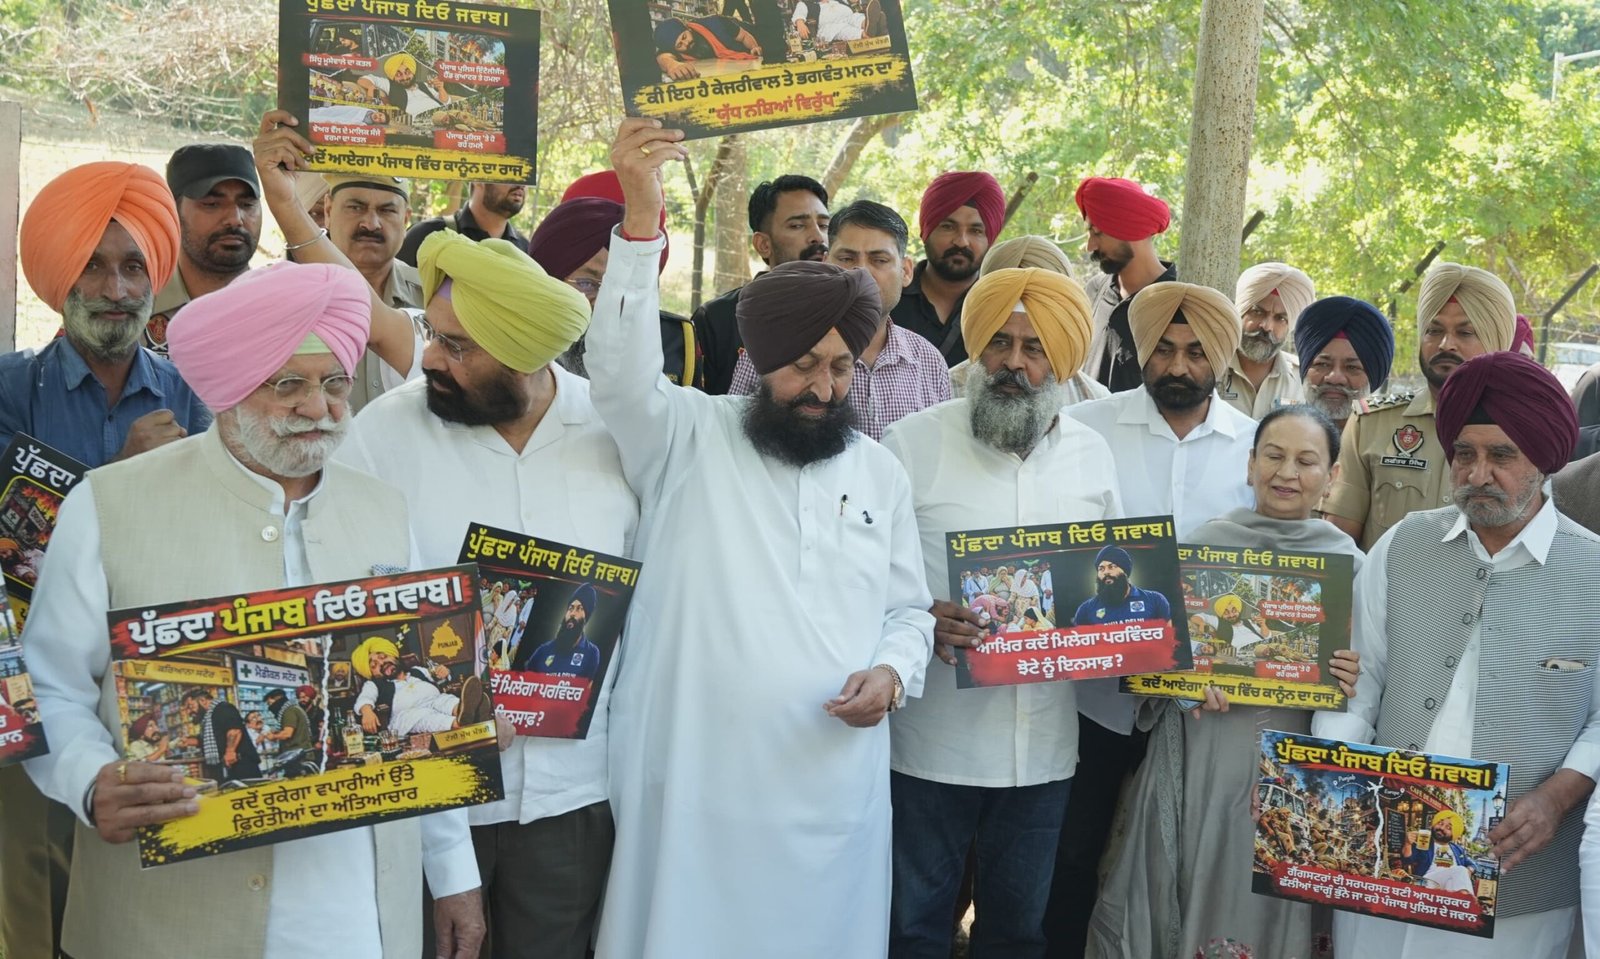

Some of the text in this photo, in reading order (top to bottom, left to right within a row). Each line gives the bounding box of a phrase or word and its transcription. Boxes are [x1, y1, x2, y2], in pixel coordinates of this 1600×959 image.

[306, 0, 356, 13] ਪੁਛਦਾ
[362, 0, 410, 17] ਪਜਾਬ
[415, 0, 450, 20] ਦਿਓ
[647, 61, 892, 104] ਕੀ ਇਹ ਹੈ ਕੇਜਰੀਵਾਲ ਤੇ ਭਗਵੰਤ ਮਾਨ ਦਾ
[328, 150, 375, 167] ਆਏਗਾ
[376, 152, 413, 169] ਪੰਜਾਬ
[415, 155, 441, 171] ਵਿੱਚ
[481, 163, 497, 174] ਦਾ
[498, 164, 523, 176] ਰਾਜ
[12, 444, 77, 487] ਪੁੱਛਦਾ
[467, 527, 516, 560] ਪੁੱਛਦਾ
[519, 539, 561, 570] ਪੰਜਾਬ
[562, 549, 594, 577] ਦਿਓ
[951, 533, 1004, 558] ਪੁੱਛਦਾ
[1010, 529, 1062, 549] ਪੰਜਾਬ
[1068, 523, 1107, 544] ਦਿਓ
[1197, 546, 1237, 564] ਪੰਜਾਬ
[1242, 548, 1274, 566] ਦਿਓ
[127, 609, 215, 654] ਪੁੱਛਦਾ
[219, 597, 306, 635] ਪੰਜਾਬ
[313, 585, 368, 623] ਦਿਓ
[437, 640, 459, 649] PUNJAB
[1025, 633, 1049, 651] ਕਦੋਂ
[1050, 630, 1101, 649] ਮਿਲੇਗਾ
[1102, 625, 1164, 645] ਪਰਵਿੰਦਰ
[254, 665, 297, 682] ਮੈਡੀਕਲ ਸਟੋਰ
[1017, 658, 1040, 676] ਝੋਟੇ
[1041, 656, 1055, 678] ਨੂੰ
[499, 674, 539, 697] ਮਿਲੇਗਾ
[539, 680, 584, 701] ਪਰਵਿੰਦਰ
[1141, 675, 1162, 689] ਕਦੋਂ
[1162, 677, 1202, 692] ਆਏਗਾ
[1238, 682, 1261, 697] ਵਿੱਚ
[1297, 691, 1312, 702] ਦਾ
[1313, 692, 1335, 704] ਰਾਜ
[1276, 738, 1328, 763] ਪੁੱਛਦਾ
[1331, 745, 1382, 772] ਪੰਜਾਬ
[1386, 751, 1426, 777] ਦਿਓ
[230, 789, 259, 811] ਕਦੋਂ
[315, 769, 385, 797] ਵਪਾਰੀਆਂ
[389, 763, 415, 787] ਉੱਤੇ
[1338, 774, 1356, 783] Punjab
[1383, 788, 1400, 796] Europe
[309, 803, 328, 818] ਦਾ
[331, 787, 418, 813] ਅੱਤਿਆਚਾਰ
[1332, 874, 1344, 886] ਦੀ
[1346, 878, 1390, 894] ਸਰਪਰਸਤ
[1413, 890, 1434, 902] ਆਪ
[1435, 895, 1471, 909] ਸਰਕਾਰ
[1351, 891, 1363, 900] ਜਾ
[1364, 893, 1380, 904] ਰਹੇ
[1381, 895, 1409, 910] ਪੰਜਾਬ
[1409, 901, 1438, 915] ਪੁਲਿਸ
[1439, 905, 1449, 918] ਦੇ
[1449, 909, 1478, 922] ਜਵਾਨ
